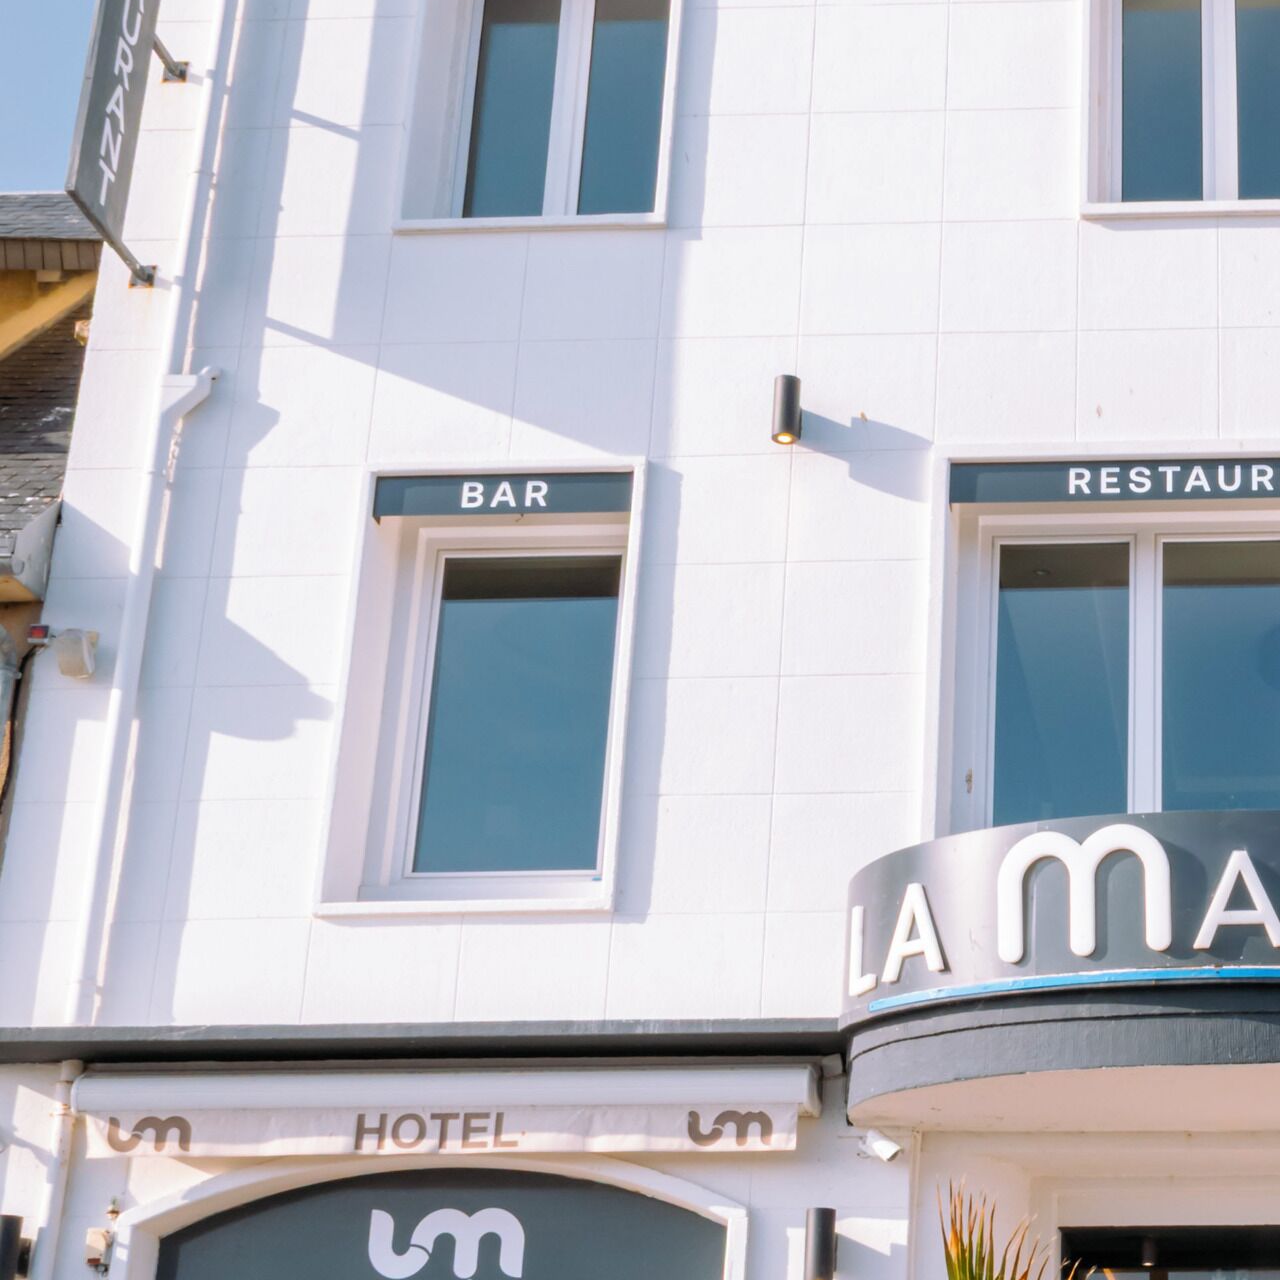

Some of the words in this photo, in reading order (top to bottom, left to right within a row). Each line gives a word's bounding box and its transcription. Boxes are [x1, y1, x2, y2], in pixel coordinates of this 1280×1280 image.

[460, 480, 549, 509] BAR
[848, 882, 945, 998] LA
[354, 1112, 519, 1150] HOTEL
